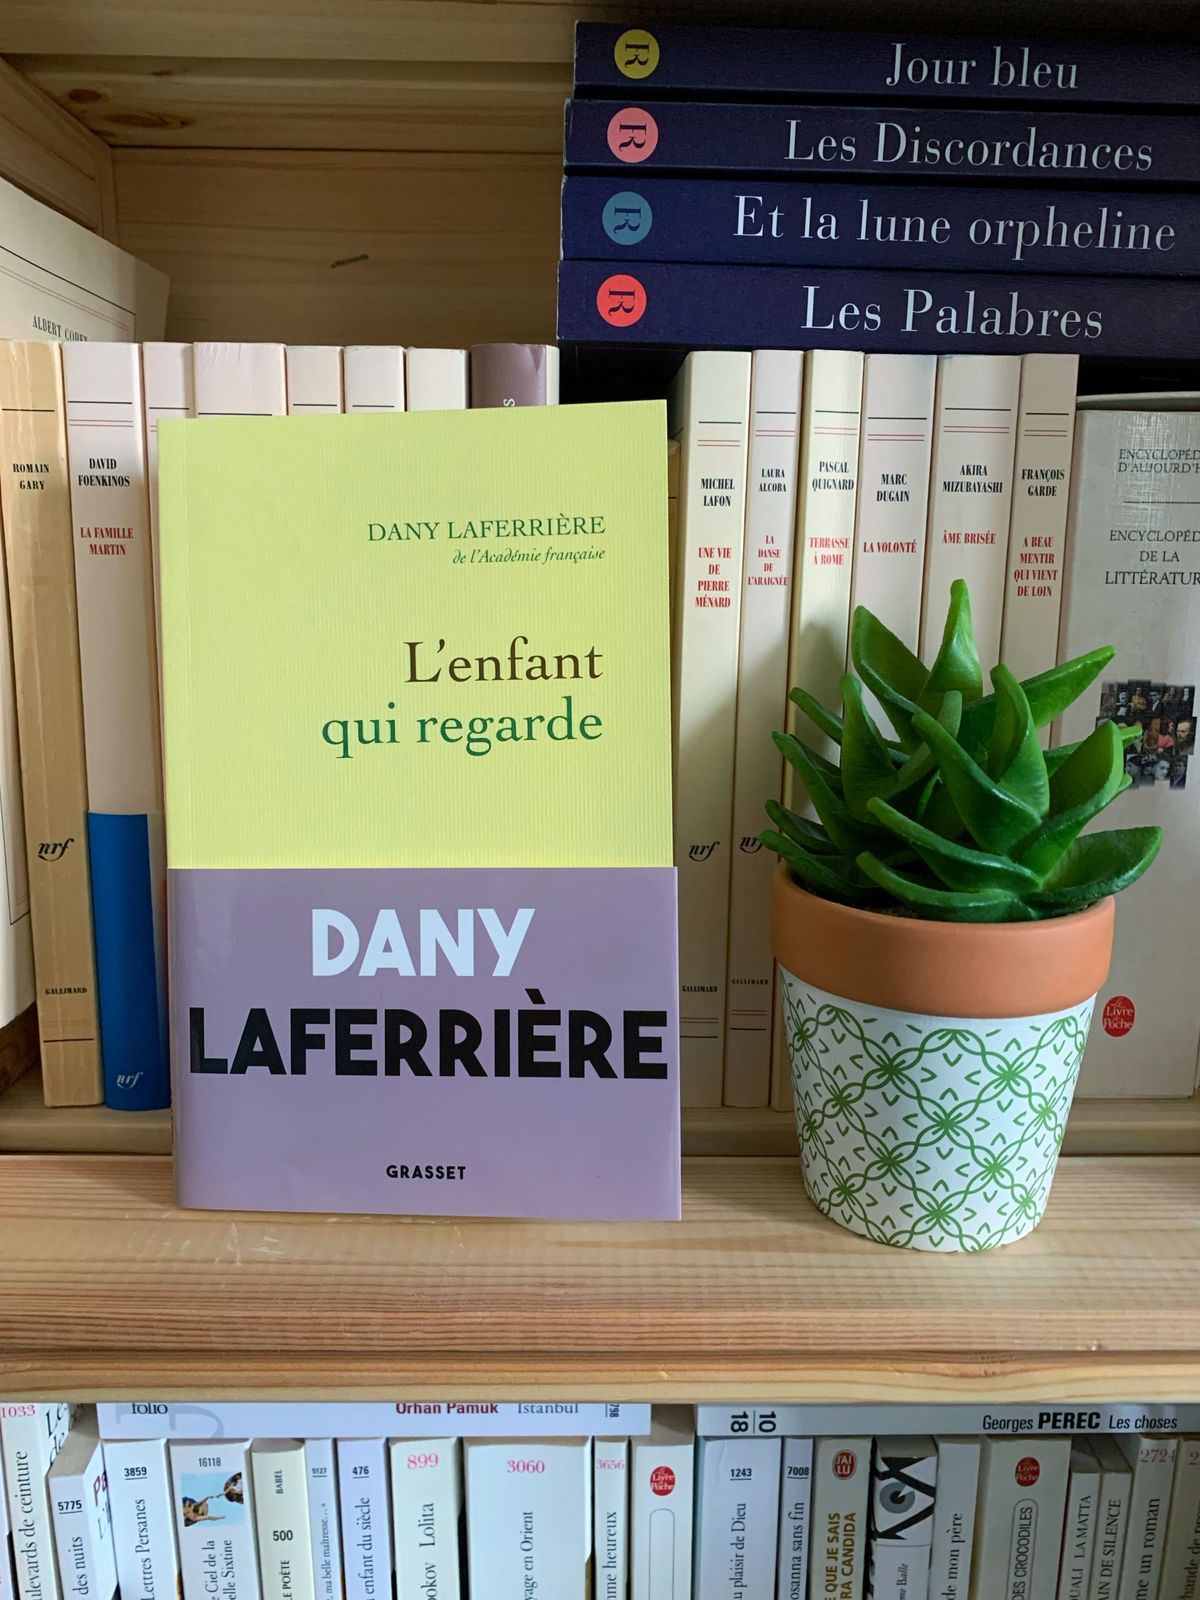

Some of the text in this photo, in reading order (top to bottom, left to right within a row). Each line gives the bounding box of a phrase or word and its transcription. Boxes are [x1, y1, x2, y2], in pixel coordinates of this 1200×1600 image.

[886, 42, 1079, 89] Jour bleu
[784, 119, 1153, 171] Les Discordances
[733, 195, 1176, 260] Et la lune orpheline
[801, 285, 1103, 339] Les Palabres
[32, 314, 62, 338] ALBERT
[13, 463, 50, 473] ROMAIN
[89, 458, 117, 470] DAVID
[819, 461, 849, 473] PASCAL
[959, 464, 988, 476] AKIRA
[761, 468, 785, 478] LAURA
[880, 474, 908, 485] MARC
[1021, 469, 1065, 483] FRANÇOIS
[19, 480, 45, 490] GARY
[78, 475, 130, 487] FOENKINOS
[700, 478, 735, 490] MICHEL
[758, 483, 787, 492] ALCOBA
[812, 479, 855, 491] QUIGNARD
[942, 481, 1003, 493] MIZUBAYASHI
[876, 490, 910, 502] DUGAIN
[1028, 486, 1057, 497] GARDE
[703, 496, 731, 506] LAFON
[80, 527, 134, 539] LA FAMILLE
[368, 513, 606, 541] DANY LAFERRIÈRE
[765, 535, 774, 544] LA
[809, 537, 850, 549] TERRASSE
[941, 530, 996, 544] ÂME BRISÉE
[1023, 537, 1054, 548] A BEAU
[89, 544, 126, 555] MARTIN
[698, 547, 732, 558] UNE VIE
[863, 539, 917, 553] LA VOLONTÉ
[452, 546, 606, 565] de l'Académie française
[758, 549, 780, 558] DANSE
[813, 551, 845, 565] À ROME
[1019, 553, 1055, 564] MENTIR
[1139, 551, 1180, 562] DE LA
[708, 564, 720, 575] DE
[764, 563, 774, 572] DE
[748, 575, 789, 586] L'ARAIGNÉE
[1013, 570, 1058, 582] QUI VIENT
[698, 581, 729, 591] PIERRE
[1017, 586, 1052, 597] DE LOIN
[695, 594, 731, 608] MÉNARD
[403, 635, 604, 683] L'enfant
[322, 695, 603, 759] qui regarde
[38, 838, 74, 861] nrf
[688, 841, 720, 862] nrf
[312, 909, 535, 977] DANY
[682, 984, 718, 993] GALLIMARD
[732, 978, 768, 986] GALLIMARD
[45, 986, 88, 995] GALLIMARD
[1106, 1006, 1134, 1016] Livre
[1104, 1018, 1134, 1030] Poche
[189, 988, 668, 1080] LAFERRIÈRE
[117, 1071, 144, 1089] nrf
[386, 1165, 466, 1180] GRASSET
[1, 1405, 36, 1418] 1033
[396, 1403, 579, 1414] Orhan Pamuk Istanbul
[983, 1412, 1178, 1432] Georges PEREC Les choses
[198, 1457, 221, 1467] 16118
[407, 1452, 439, 1469] 899
[507, 1460, 545, 1473] 3060
[124, 1467, 147, 1477] 3859
[352, 1466, 369, 1475] 476
[730, 1468, 752, 1478] 1243
[787, 1466, 809, 1476] 7008
[837, 1464, 850, 1475] LU
[15, 1451, 33, 1514] ceinture
[58, 1501, 82, 1511] 5775
[788, 1502, 804, 1521] fin
[355, 1497, 370, 1531] siècle
[731, 1503, 746, 1532] Dieu
[18, 1519, 36, 1537] de
[135, 1499, 150, 1554] Persanes
[418, 1502, 436, 1548] Lolita
[520, 1511, 534, 1552] Orient
[827, 1513, 840, 1544] SAIS
[946, 1513, 966, 1543] père
[1074, 1495, 1092, 1558] LA MATTA
[273, 1530, 293, 1541] 500
[357, 1534, 372, 1550] du
[602, 1512, 617, 1570] heureux
[730, 1535, 745, 1550] de
[791, 1524, 803, 1552] sans
[1014, 1507, 1033, 1577] CROCODILES
[1100, 1500, 1121, 1577] DE SILENCE
[1139, 1498, 1160, 1574] un roman
[202, 1540, 215, 1551] la
[841, 1512, 856, 1577] CANDIDA
[203, 1554, 217, 1567] de
[220, 1540, 235, 1578] Sixtine
[826, 1547, 839, 1561] JE
[68, 1536, 89, 1595] des nuits
[321, 1559, 332, 1579] belle
[524, 1555, 534, 1571] en
[948, 1549, 960, 1579] mon
[279, 1560, 290, 1590] POÈTE
[358, 1554, 374, 1595] enfant
[729, 1553, 748, 1588] plaisir
[204, 1571, 219, 1593] Ciel
[825, 1566, 838, 1593] QUE
